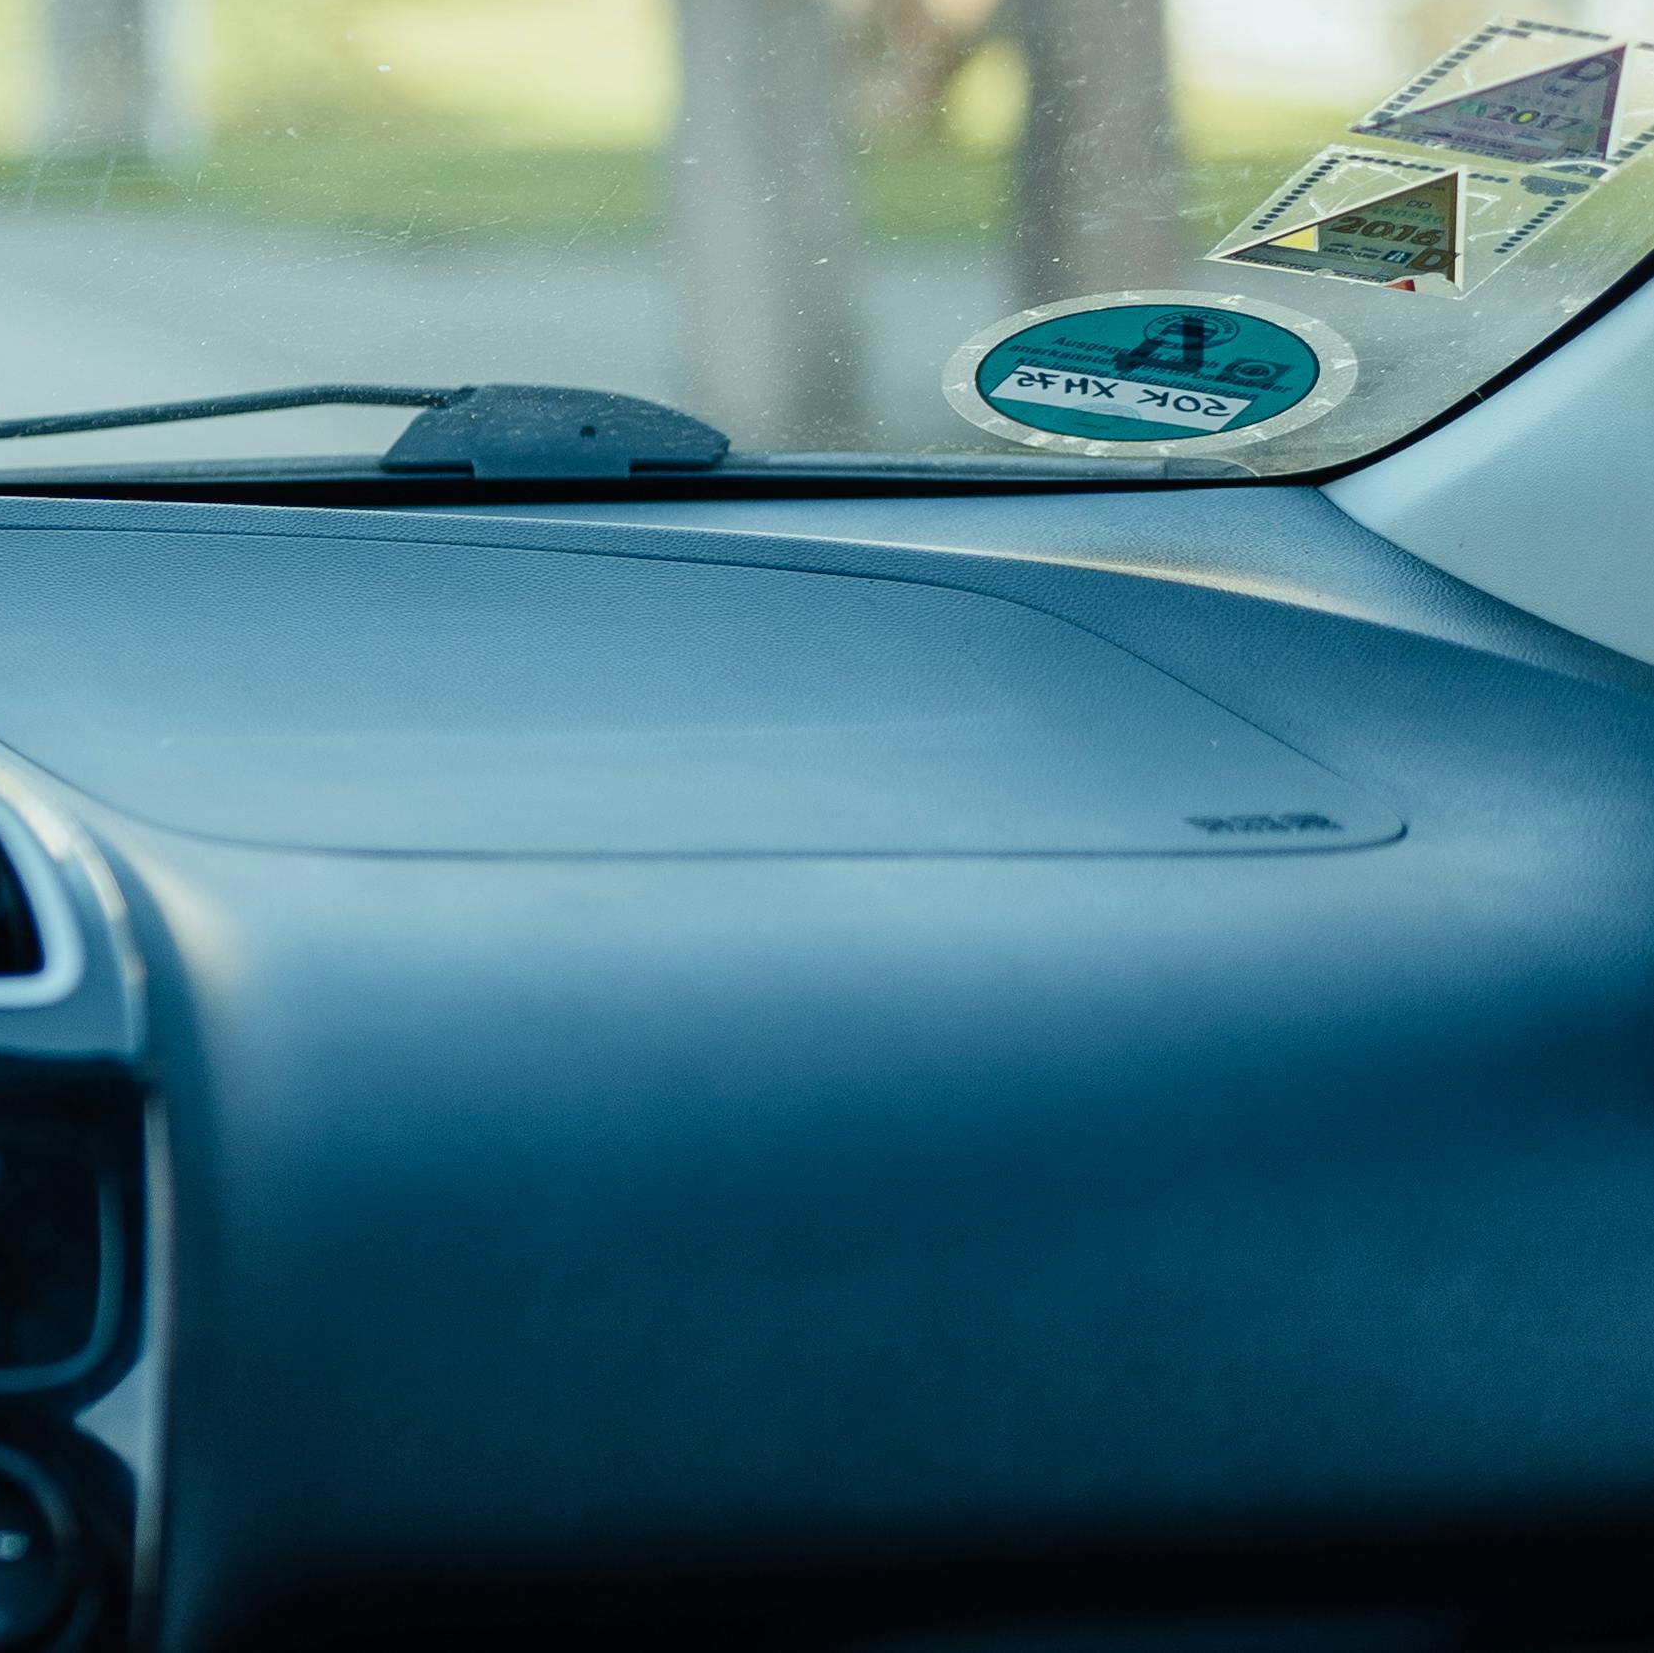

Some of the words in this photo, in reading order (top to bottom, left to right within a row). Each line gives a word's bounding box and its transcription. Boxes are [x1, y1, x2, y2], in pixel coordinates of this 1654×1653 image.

[1490, 104, 1585, 130] 2017
[1328, 215, 1444, 246] 2016
[1259, 381, 1293, 393] der
